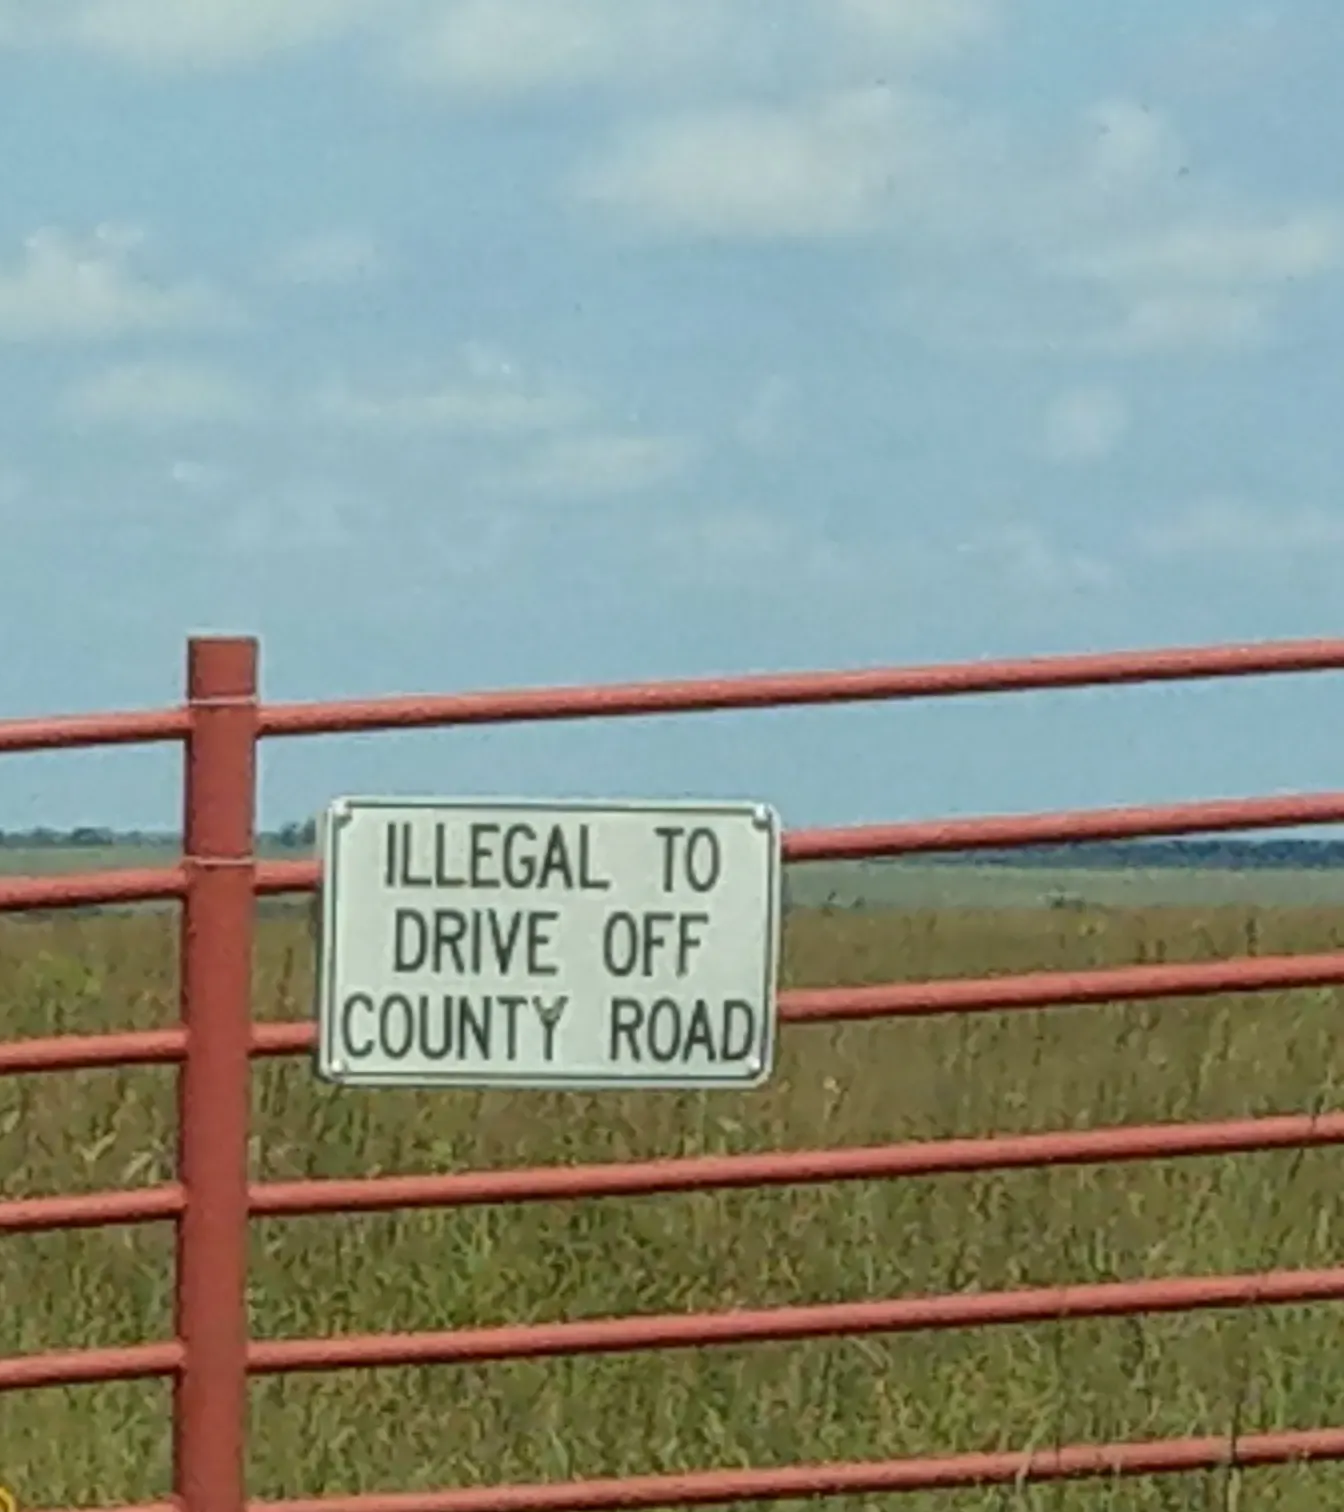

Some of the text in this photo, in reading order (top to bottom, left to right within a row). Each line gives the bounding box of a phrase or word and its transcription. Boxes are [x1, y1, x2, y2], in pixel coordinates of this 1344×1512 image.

[385, 822, 721, 892] ILLEGAL TO
[393, 908, 710, 977] DRIVE OFF
[341, 993, 755, 1061] COUNTY ROAD
